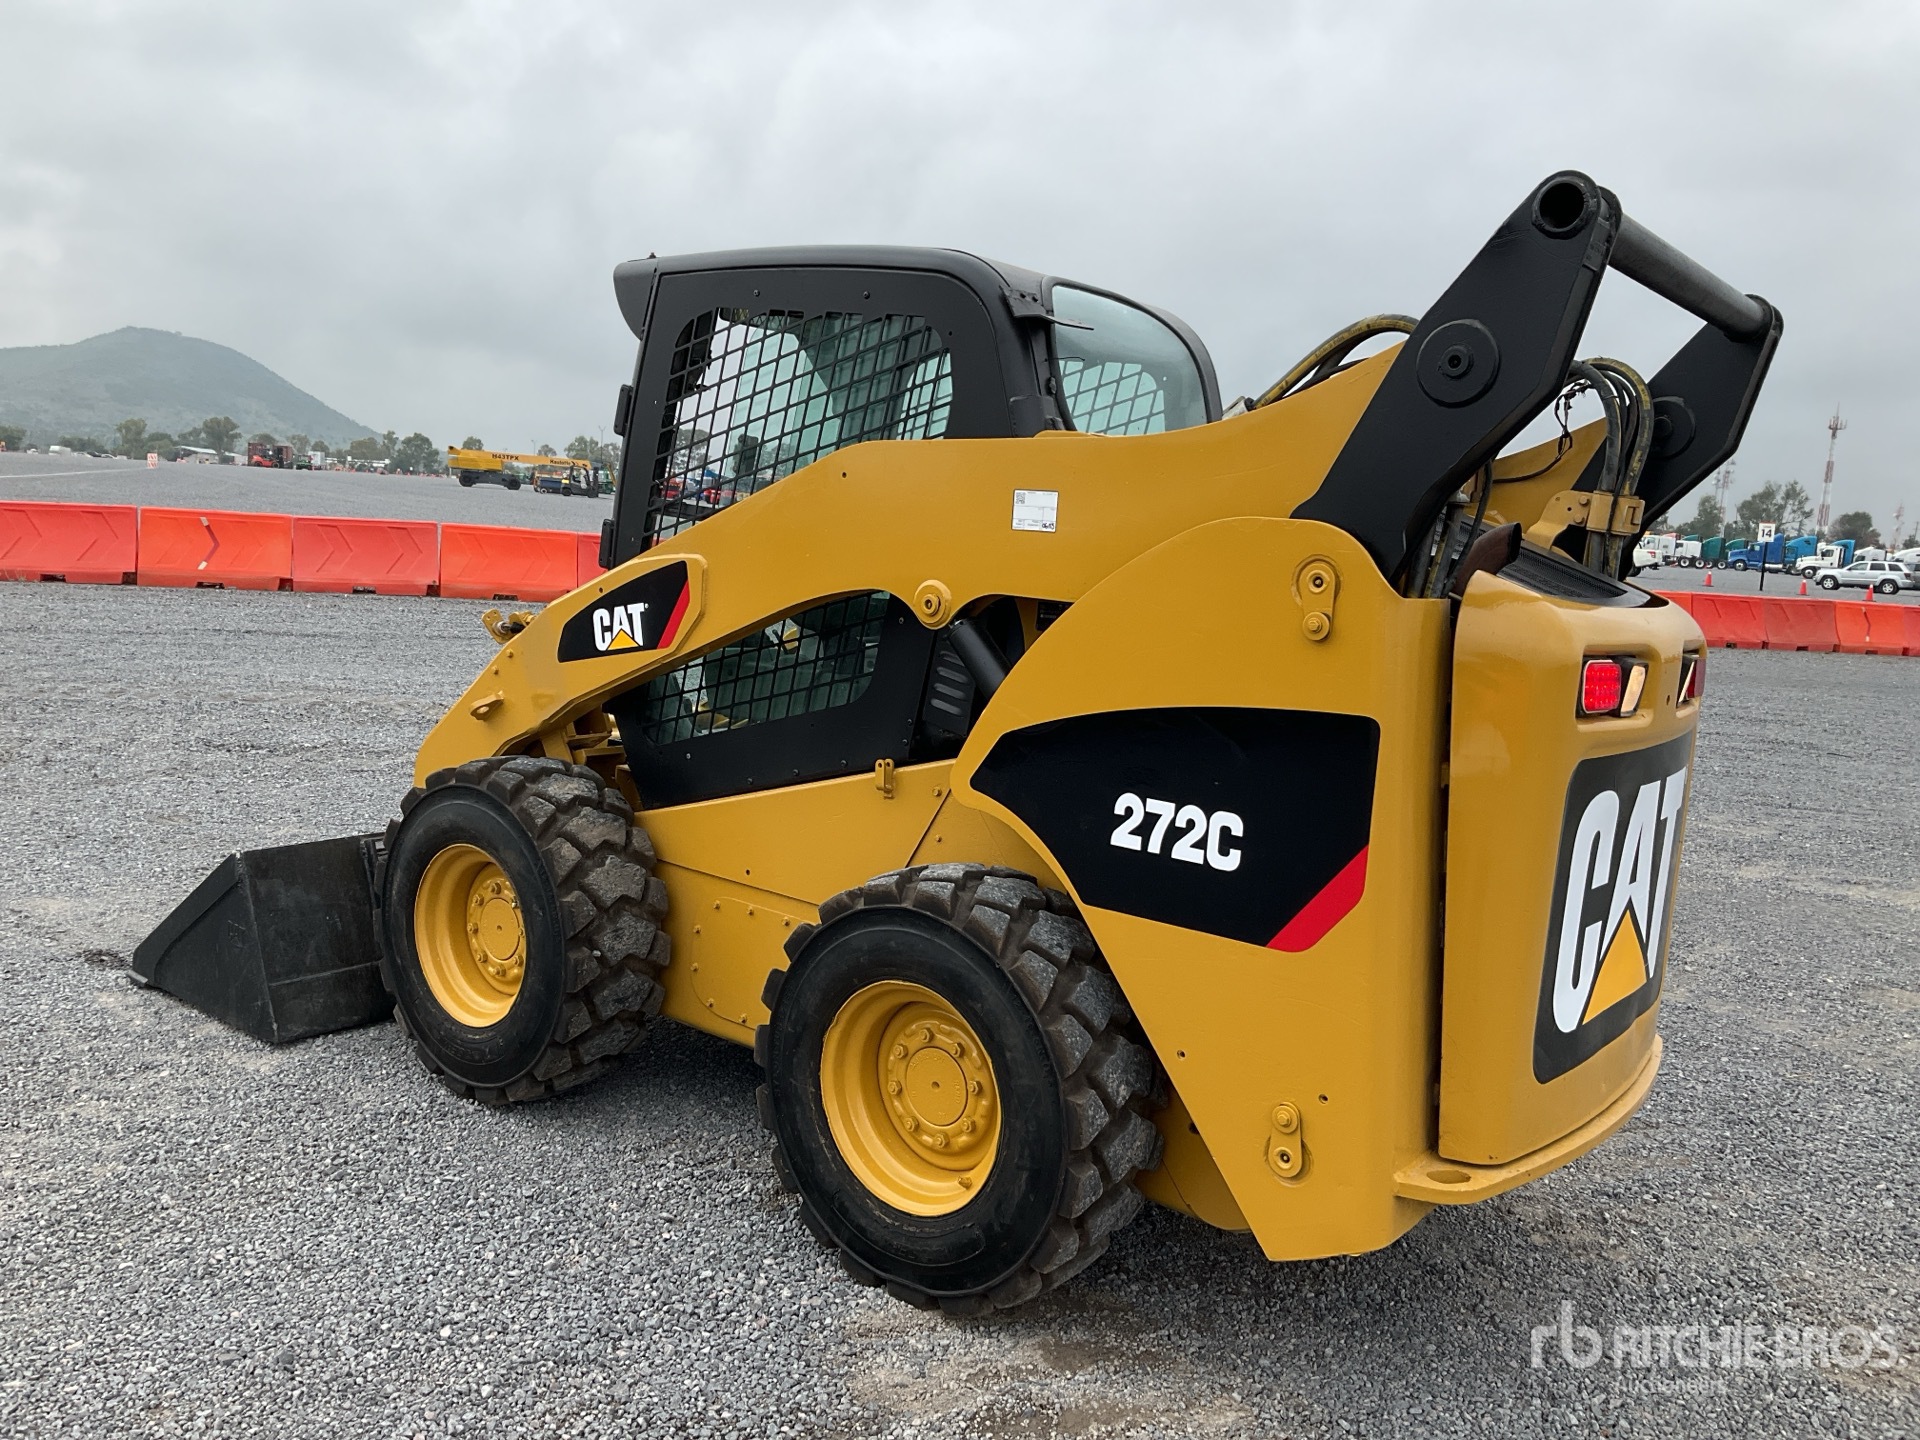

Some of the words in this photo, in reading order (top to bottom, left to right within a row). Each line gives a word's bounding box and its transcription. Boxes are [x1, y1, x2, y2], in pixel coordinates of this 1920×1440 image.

[491, 453, 519, 461] H43TPX
[1761, 529, 1772, 538] 14
[592, 602, 645, 651] CAT
[1110, 792, 1244, 871] 272C
[1552, 766, 1687, 1033] CAT
